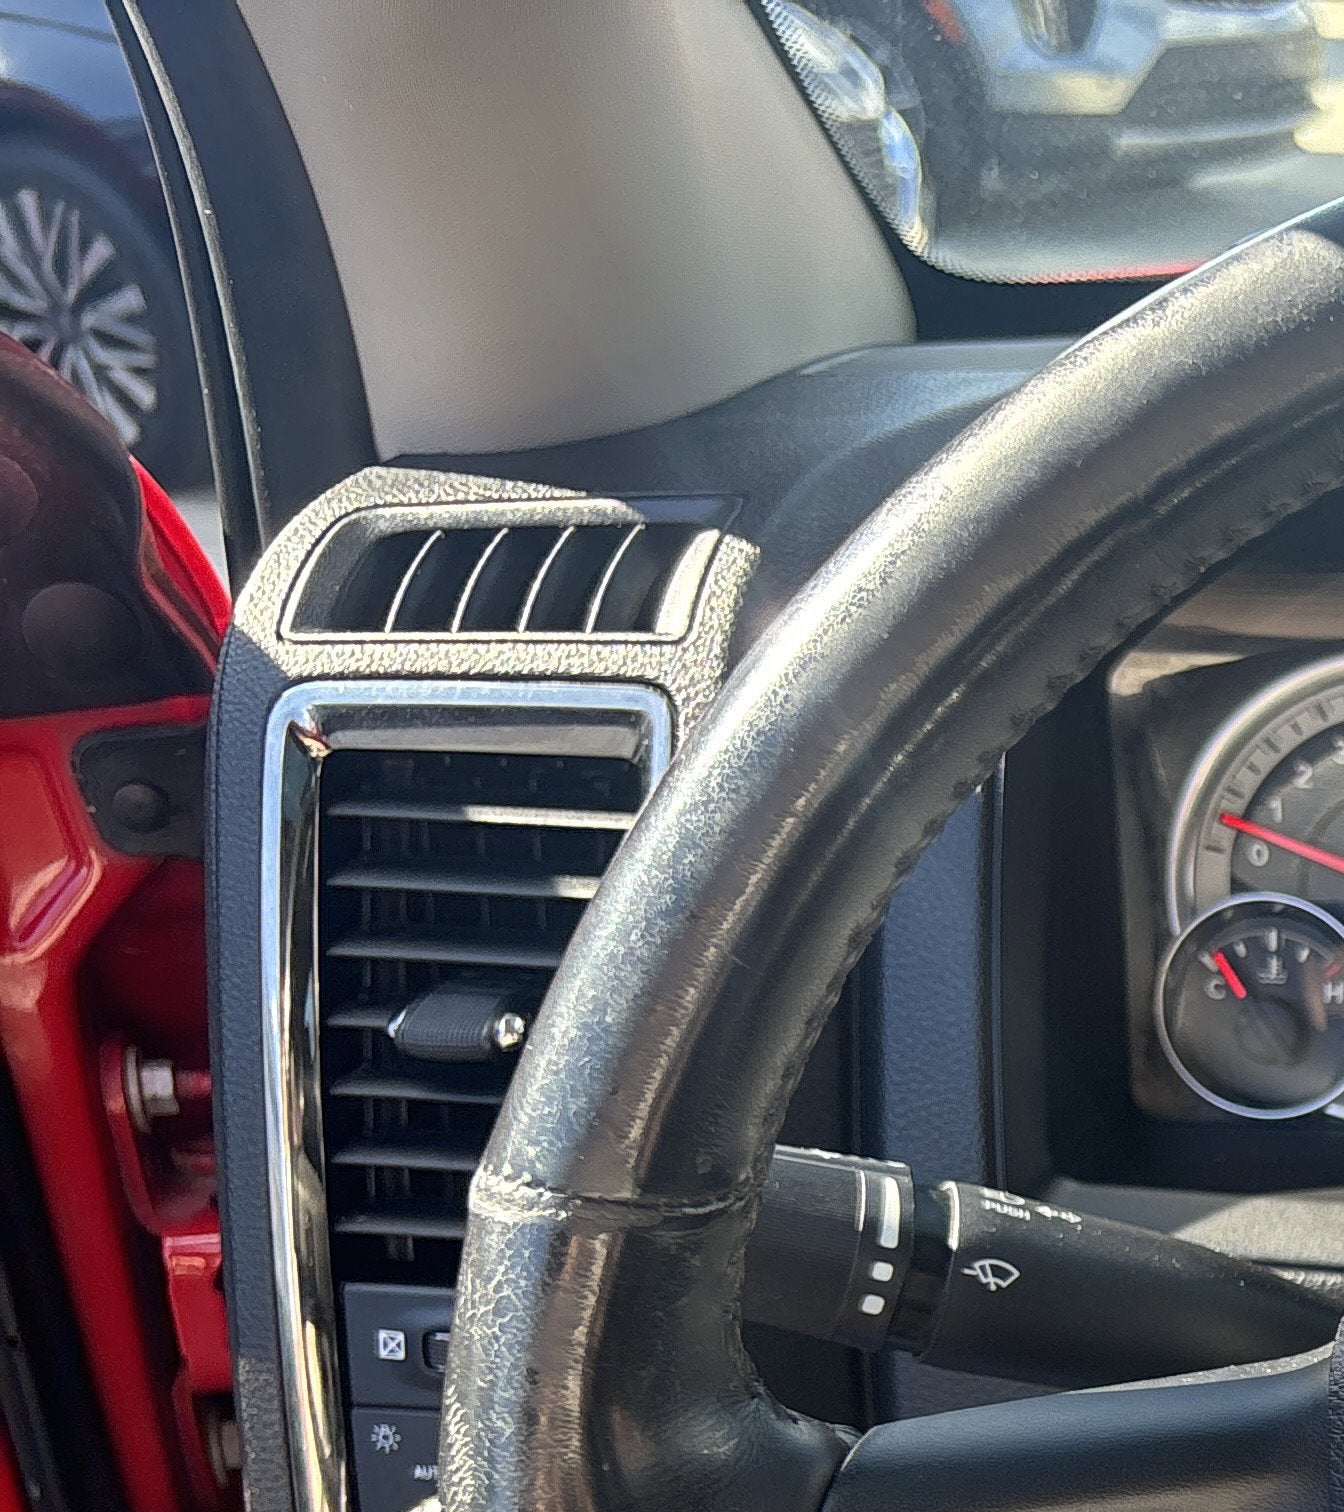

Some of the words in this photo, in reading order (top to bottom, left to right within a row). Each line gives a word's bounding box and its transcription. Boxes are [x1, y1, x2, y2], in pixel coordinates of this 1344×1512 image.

[1293, 760, 1314, 789] 2
[1268, 797, 1284, 824] 1
[1249, 841, 1270, 867] 0
[1204, 975, 1227, 1000] C
[1322, 980, 1344, 1004] H
